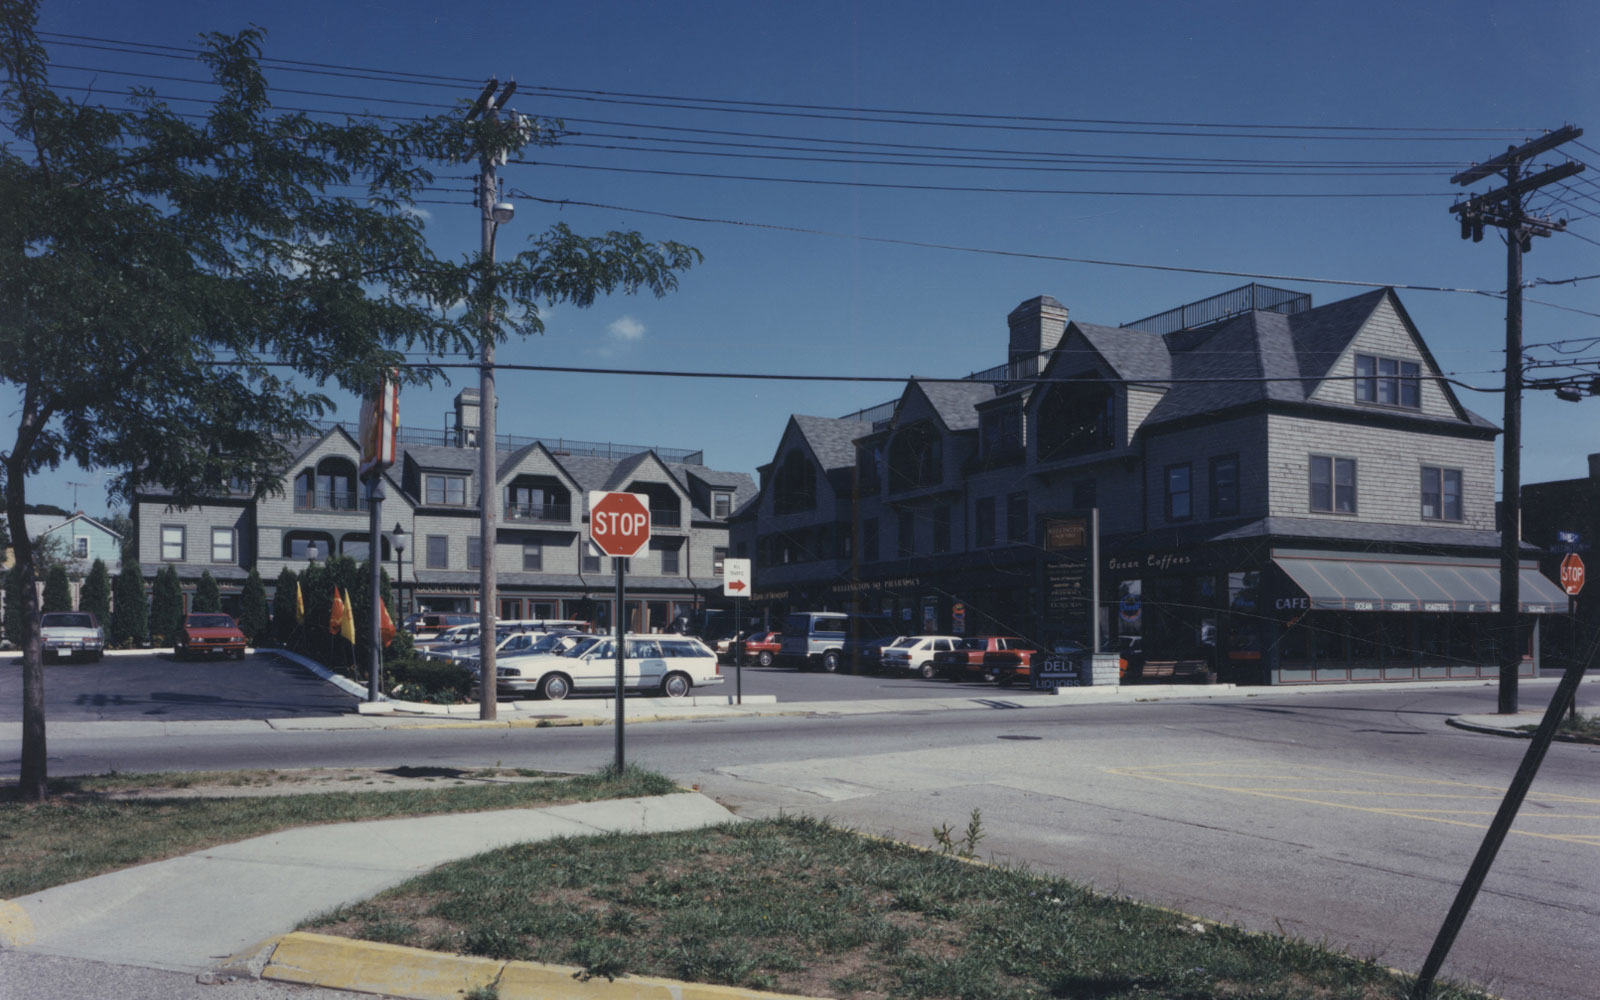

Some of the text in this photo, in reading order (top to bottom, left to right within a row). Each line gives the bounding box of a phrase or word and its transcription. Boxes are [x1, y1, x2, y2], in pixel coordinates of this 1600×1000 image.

[594, 511, 648, 537] STOP
[1108, 553, 1191, 571] Ocean Coffees
[1562, 566, 1583, 582] STOP
[1275, 597, 1308, 610] CAFE
[1354, 602, 1373, 610] OCEAN
[1391, 602, 1411, 611] COFFEE
[1424, 602, 1450, 612] ROASTERS
[1043, 661, 1074, 672] DELI
[1035, 679, 1081, 689] LIQUORS
